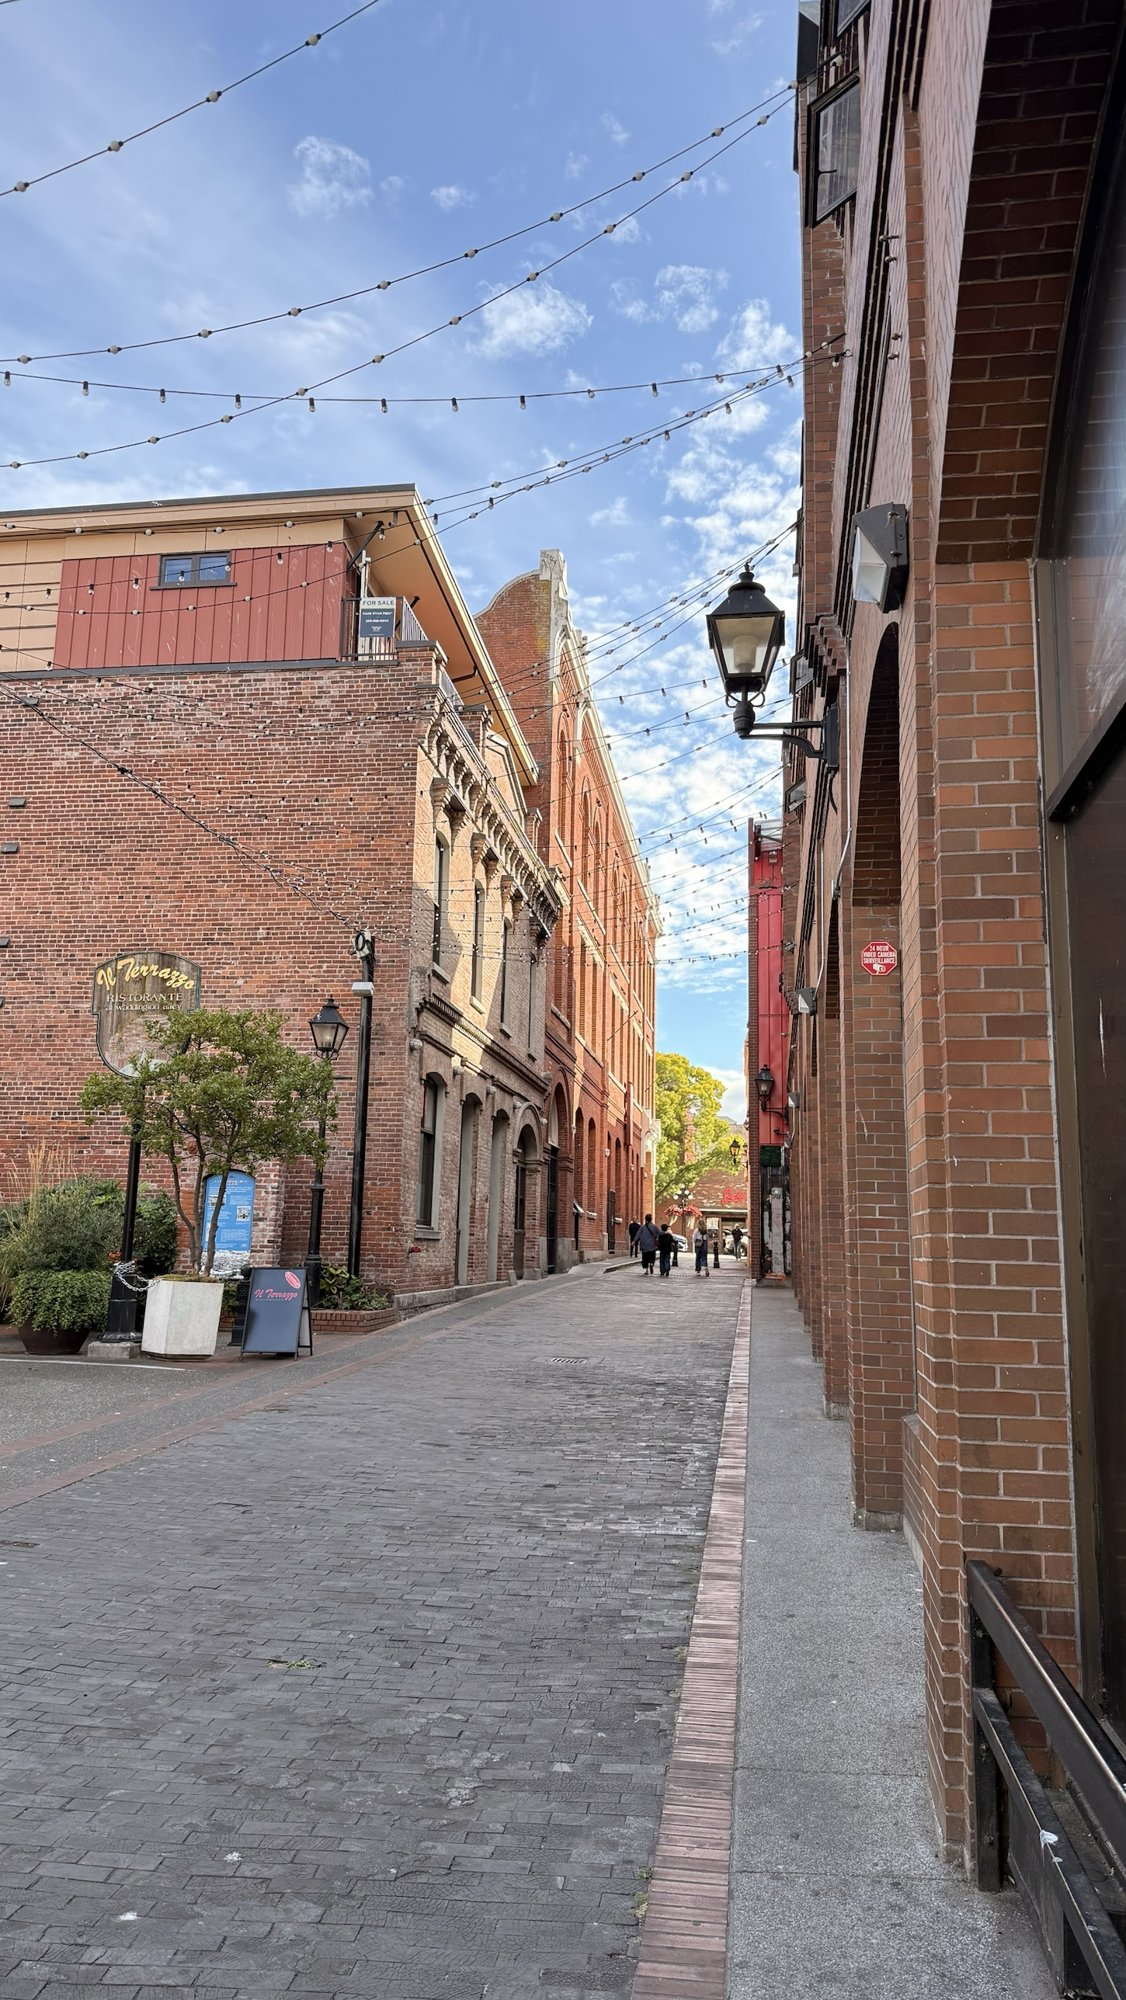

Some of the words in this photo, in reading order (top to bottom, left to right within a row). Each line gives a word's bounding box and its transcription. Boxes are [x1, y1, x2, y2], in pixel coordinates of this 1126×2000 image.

[96, 967, 117, 991] Il
[117, 957, 195, 990] Terrazzo
[106, 993, 184, 1003] RISTORANTE
[255, 1288, 265, 1298] Il
[265, 1288, 298, 1301] Terrazzo
